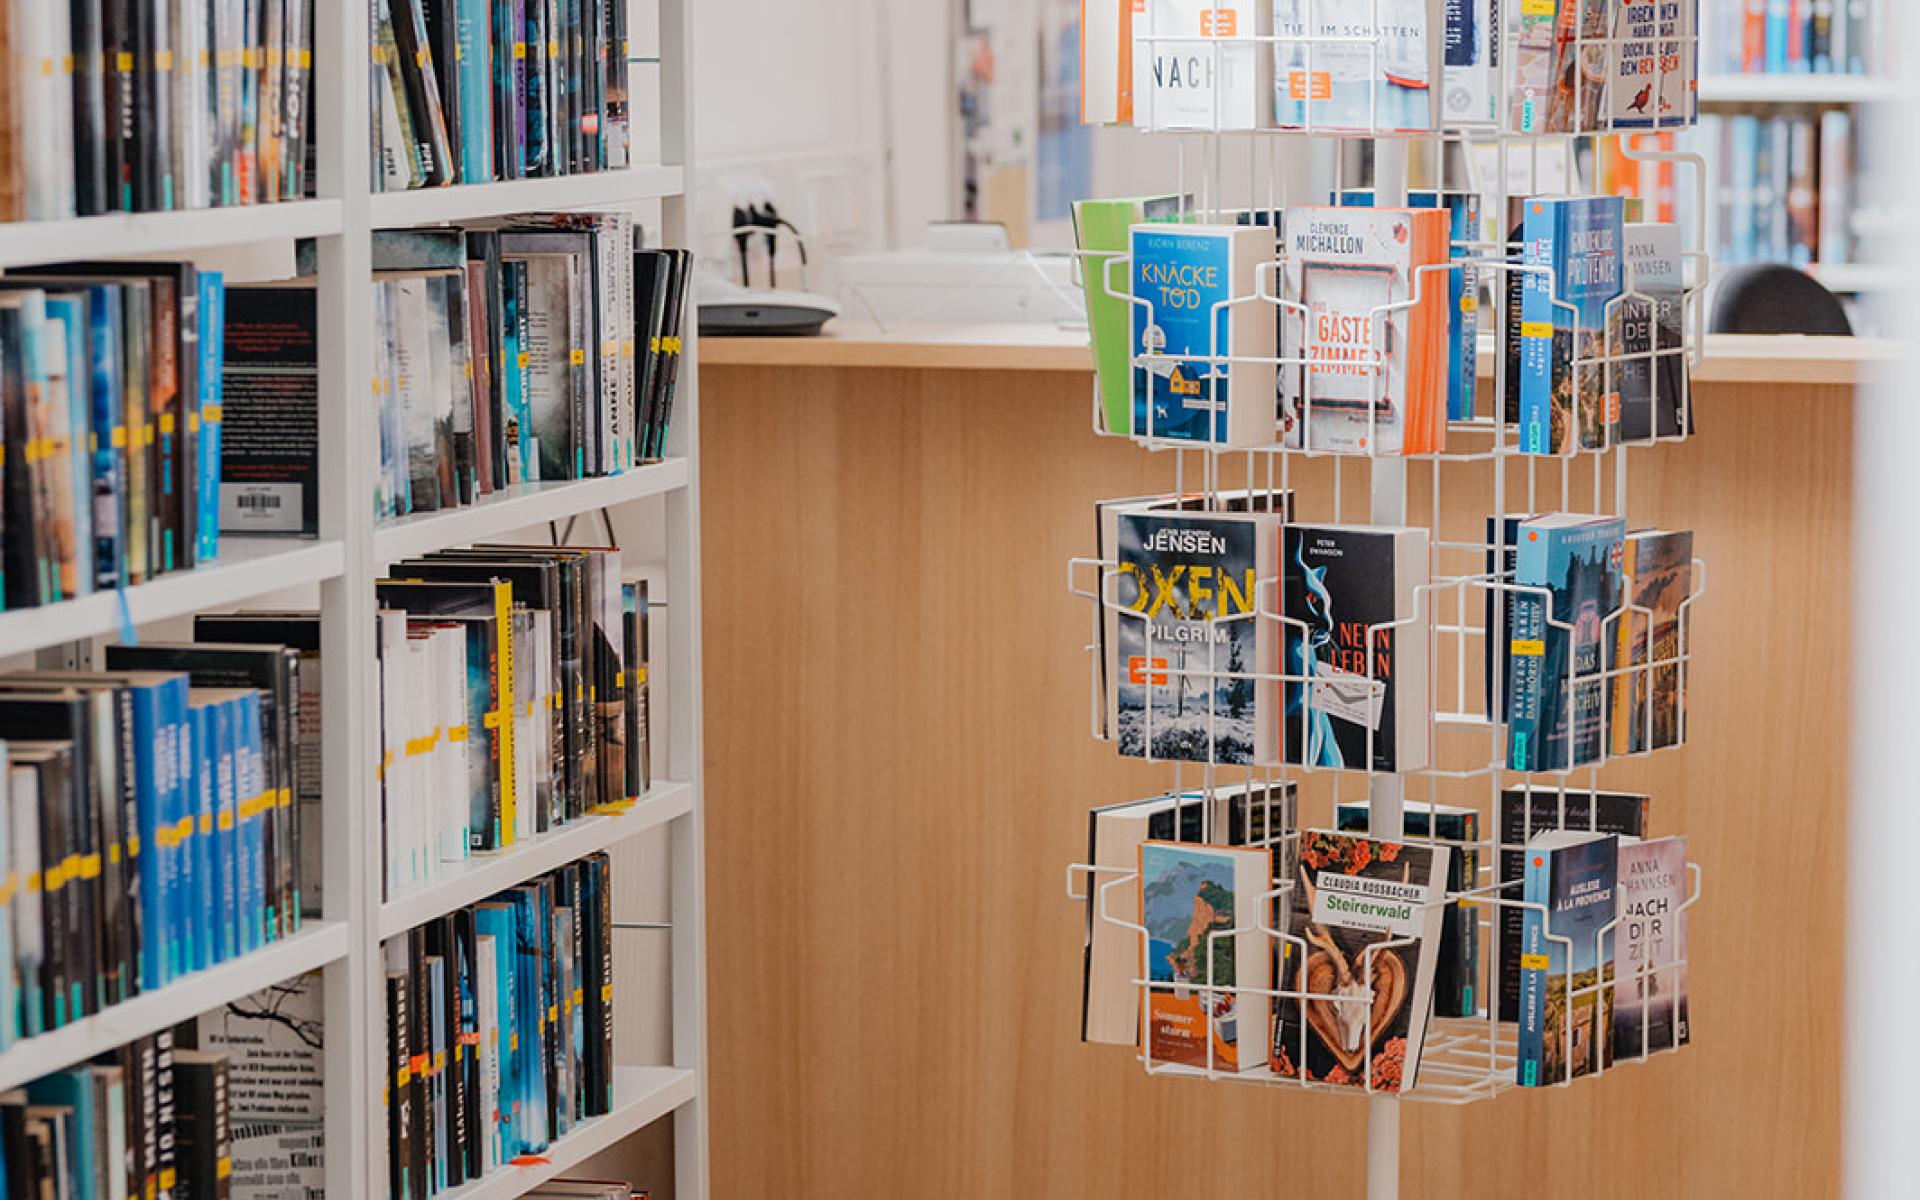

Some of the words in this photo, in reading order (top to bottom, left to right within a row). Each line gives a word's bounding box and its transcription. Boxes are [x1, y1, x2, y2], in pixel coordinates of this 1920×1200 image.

[1628, 3, 1679, 24] IRGENWEN
[1320, 25, 1336, 35] IM
[1639, 55, 1679, 75] GEWSSEN
[1296, 234, 1363, 254] MICHALLON
[1141, 260, 1218, 288] KNÄCKE
[1624, 301, 1672, 319] INTR
[1318, 311, 1370, 345] GÄSTE
[1143, 533, 1226, 555] JENSEN
[1149, 625, 1227, 643] PILGRIM
[1331, 650, 1391, 679] LEBN
[1630, 859, 1659, 874] ANNA
[1323, 876, 1360, 891] CLAUDIA
[1327, 894, 1411, 920] Steirerwald
[1629, 939, 1664, 961] ZT
